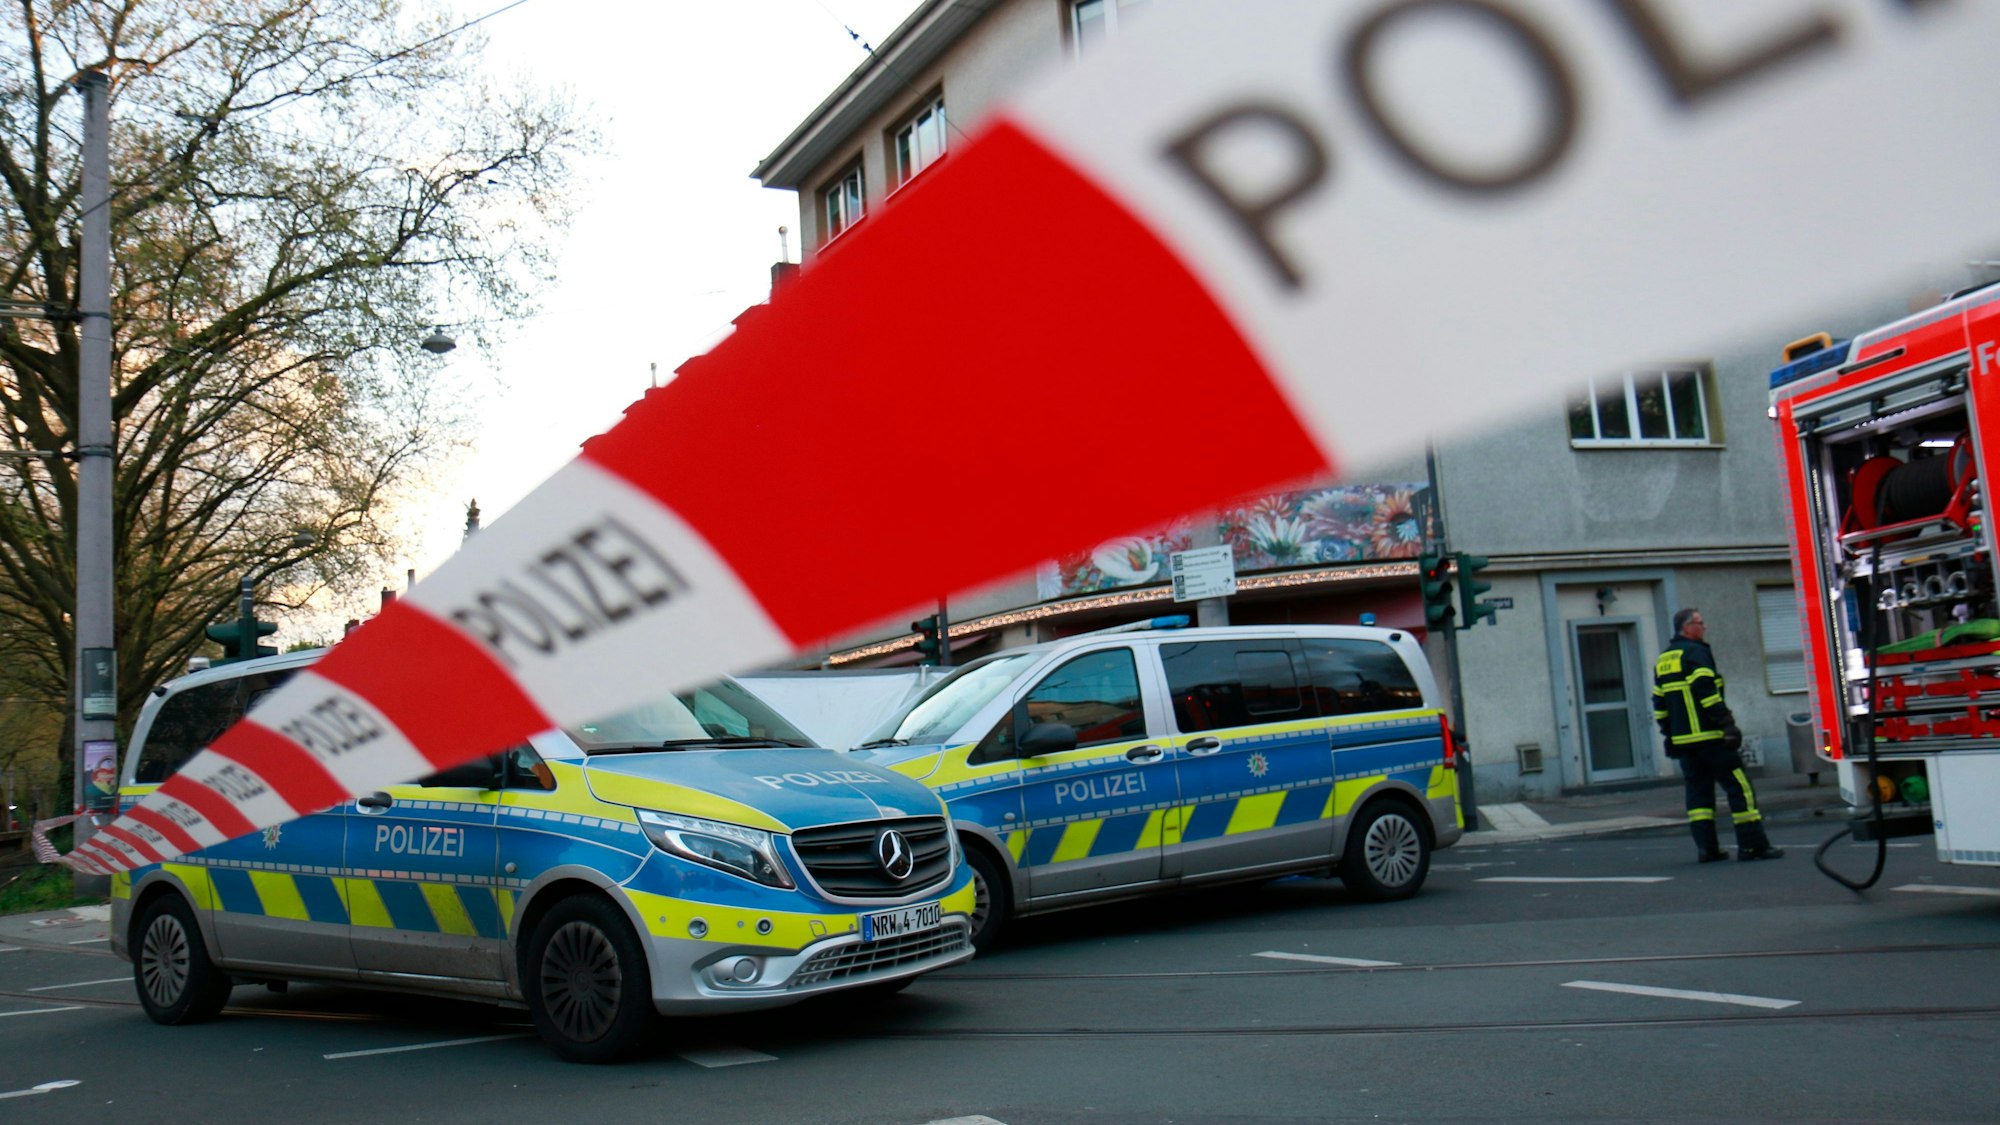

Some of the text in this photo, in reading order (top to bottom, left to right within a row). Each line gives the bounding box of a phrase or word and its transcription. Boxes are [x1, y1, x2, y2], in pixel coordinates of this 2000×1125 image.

[451, 514, 692, 668] POLIZEI
[753, 770, 889, 790] POLIZEI
[1054, 771, 1147, 805] POLIZEI
[375, 824, 465, 857] POLIZEI
[872, 904, 940, 937] NRW 4-7010
